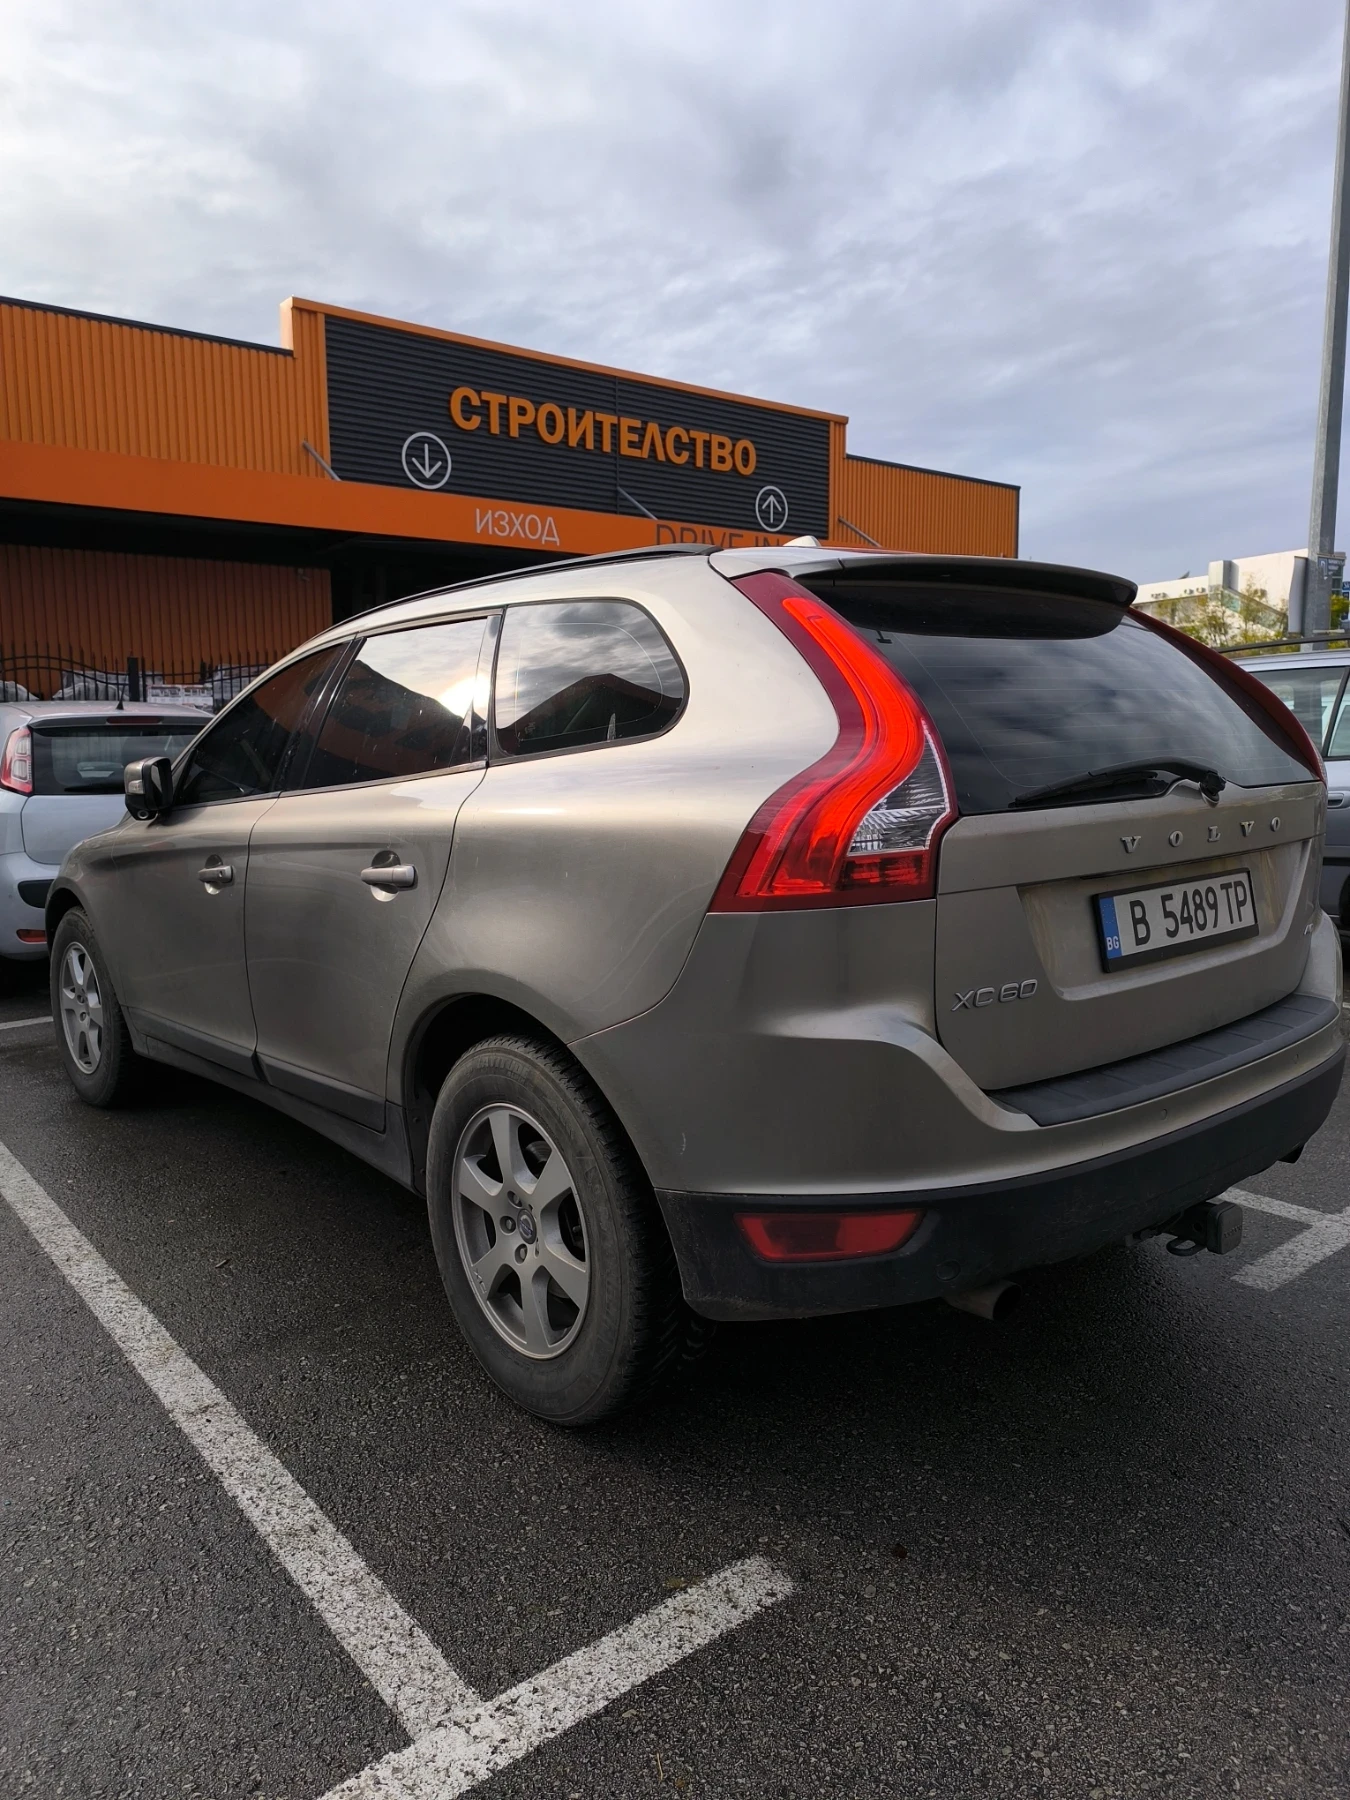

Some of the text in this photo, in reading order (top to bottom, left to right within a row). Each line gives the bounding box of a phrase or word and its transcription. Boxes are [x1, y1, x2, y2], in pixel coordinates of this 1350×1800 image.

[450, 386, 757, 476] СТРОИТЕЛСТВО
[475, 508, 560, 546] ИЗХОД
[1120, 816, 1281, 853] VOLVO
[1129, 880, 1248, 946] B 5489 TP
[1106, 936, 1120, 950] BG
